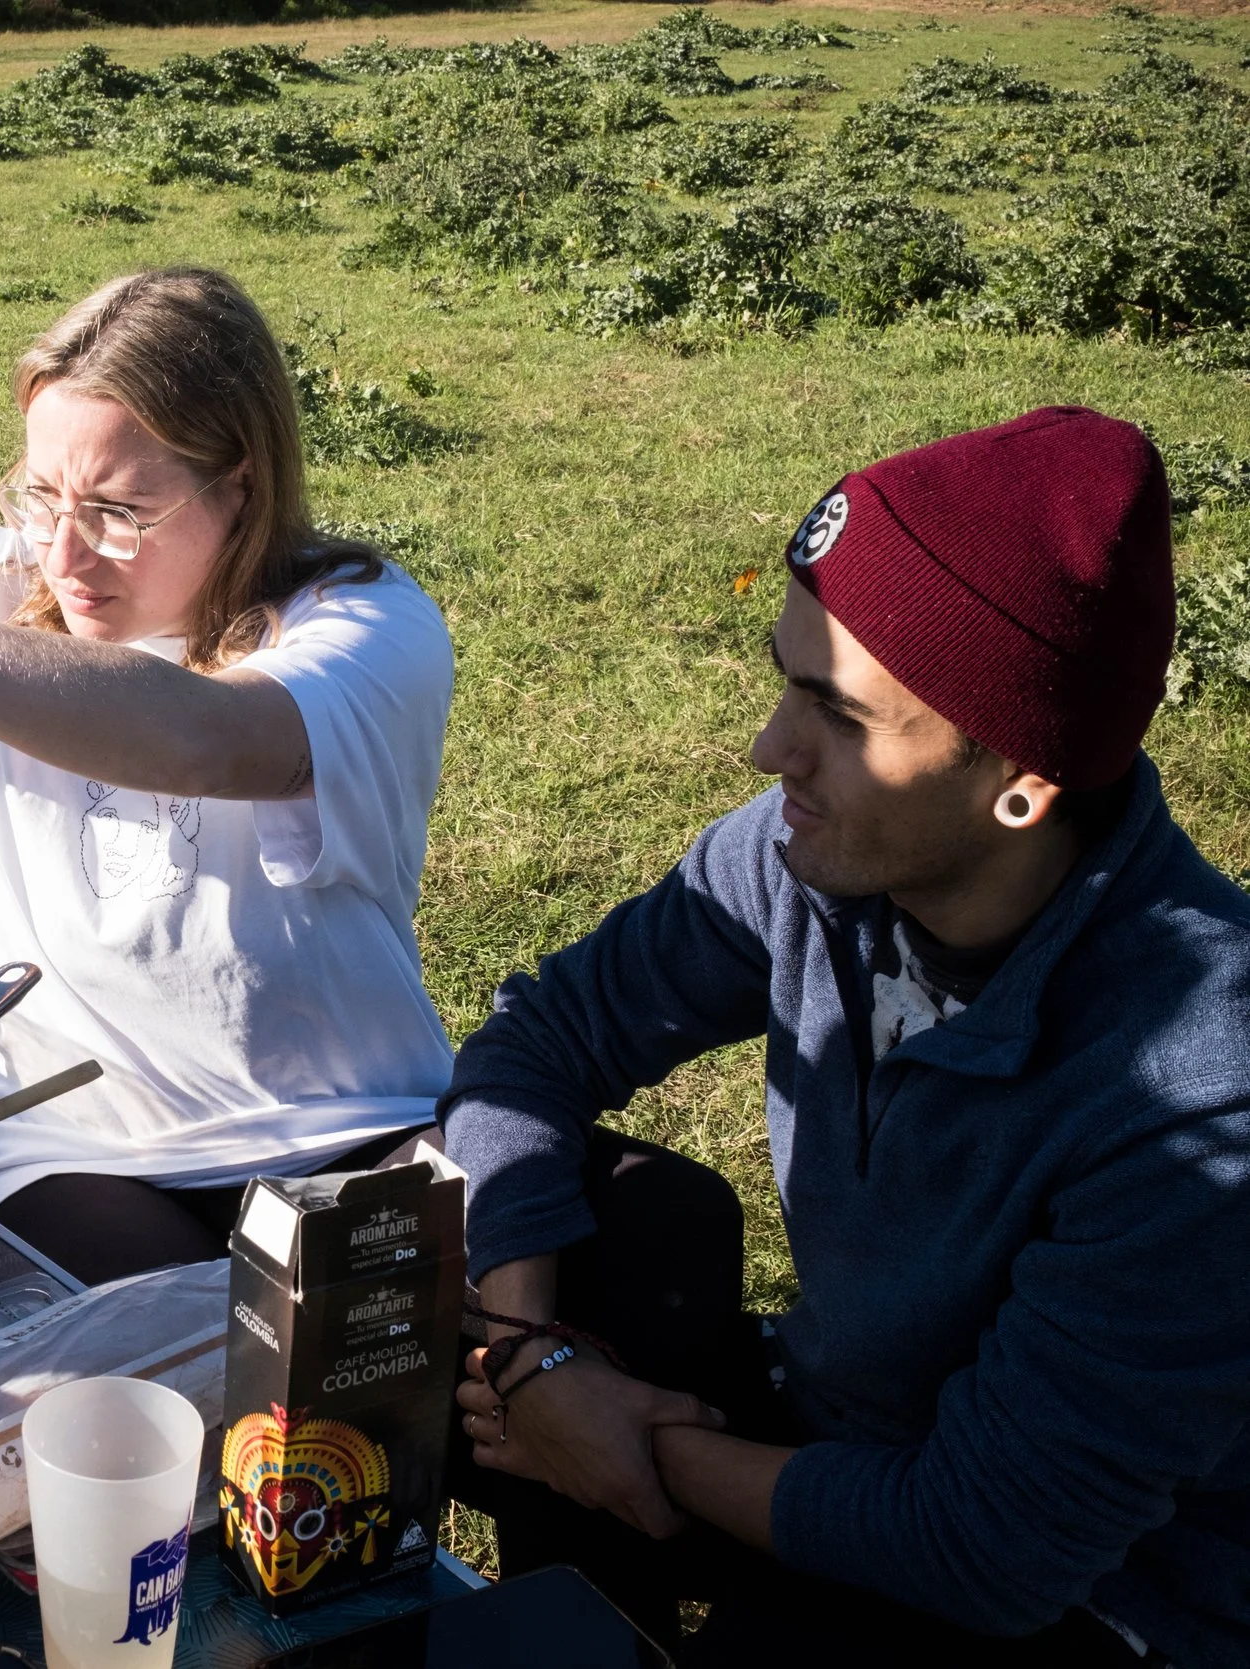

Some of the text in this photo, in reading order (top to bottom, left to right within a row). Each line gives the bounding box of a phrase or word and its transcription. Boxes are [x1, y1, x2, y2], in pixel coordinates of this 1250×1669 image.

[350, 1217, 419, 1246] AROM'ARTE
[361, 1241, 407, 1257] Tu momento
[346, 1295, 415, 1323] AROM'ARTE
[234, 1305, 280, 1353] COLOMBIA
[322, 1350, 429, 1392] COLOMBIA
[335, 1340, 418, 1371] CAFÉ MOLIDO
[135, 1573, 165, 1607] CAN
